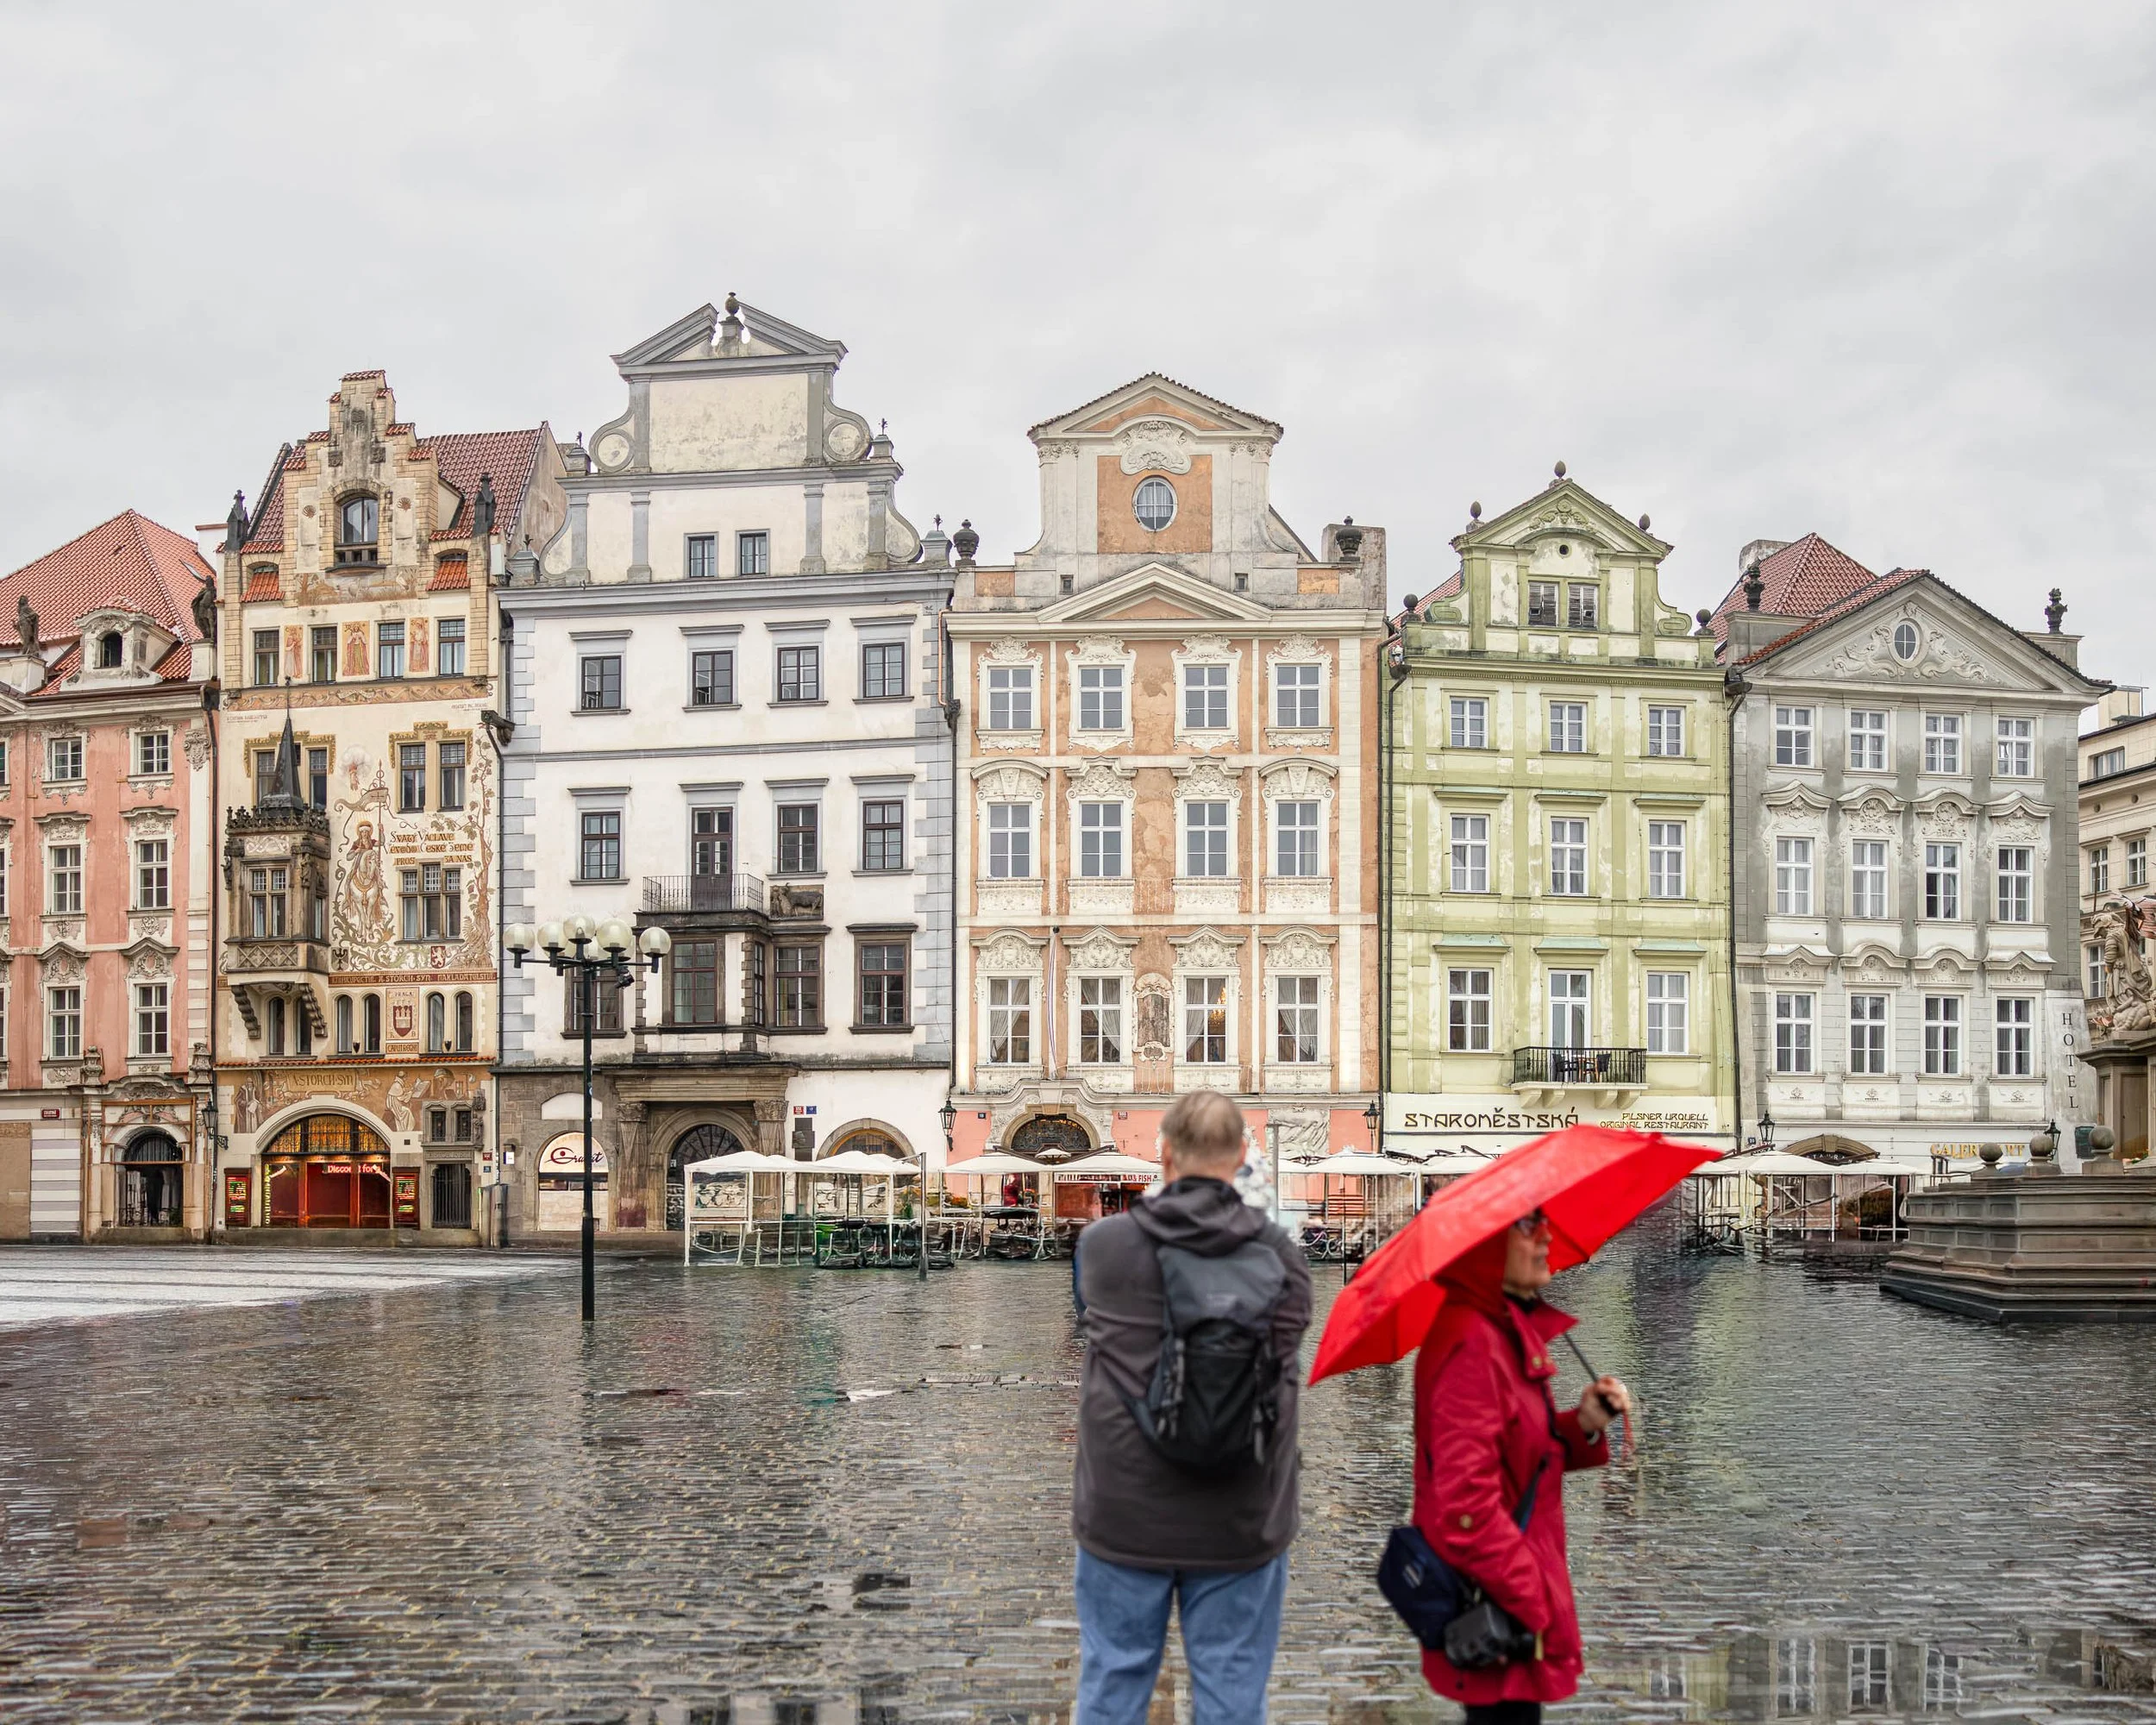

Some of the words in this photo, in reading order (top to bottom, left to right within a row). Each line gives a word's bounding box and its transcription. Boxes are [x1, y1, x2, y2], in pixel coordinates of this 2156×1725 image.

[2062, 1013, 2078, 1108] HOTEL
[1405, 1107, 1579, 1128] STAROMĚSTSKÁ
[1665, 1113, 1708, 1121] URQUELL
[1644, 1121, 1709, 1130] RESTAURANT
